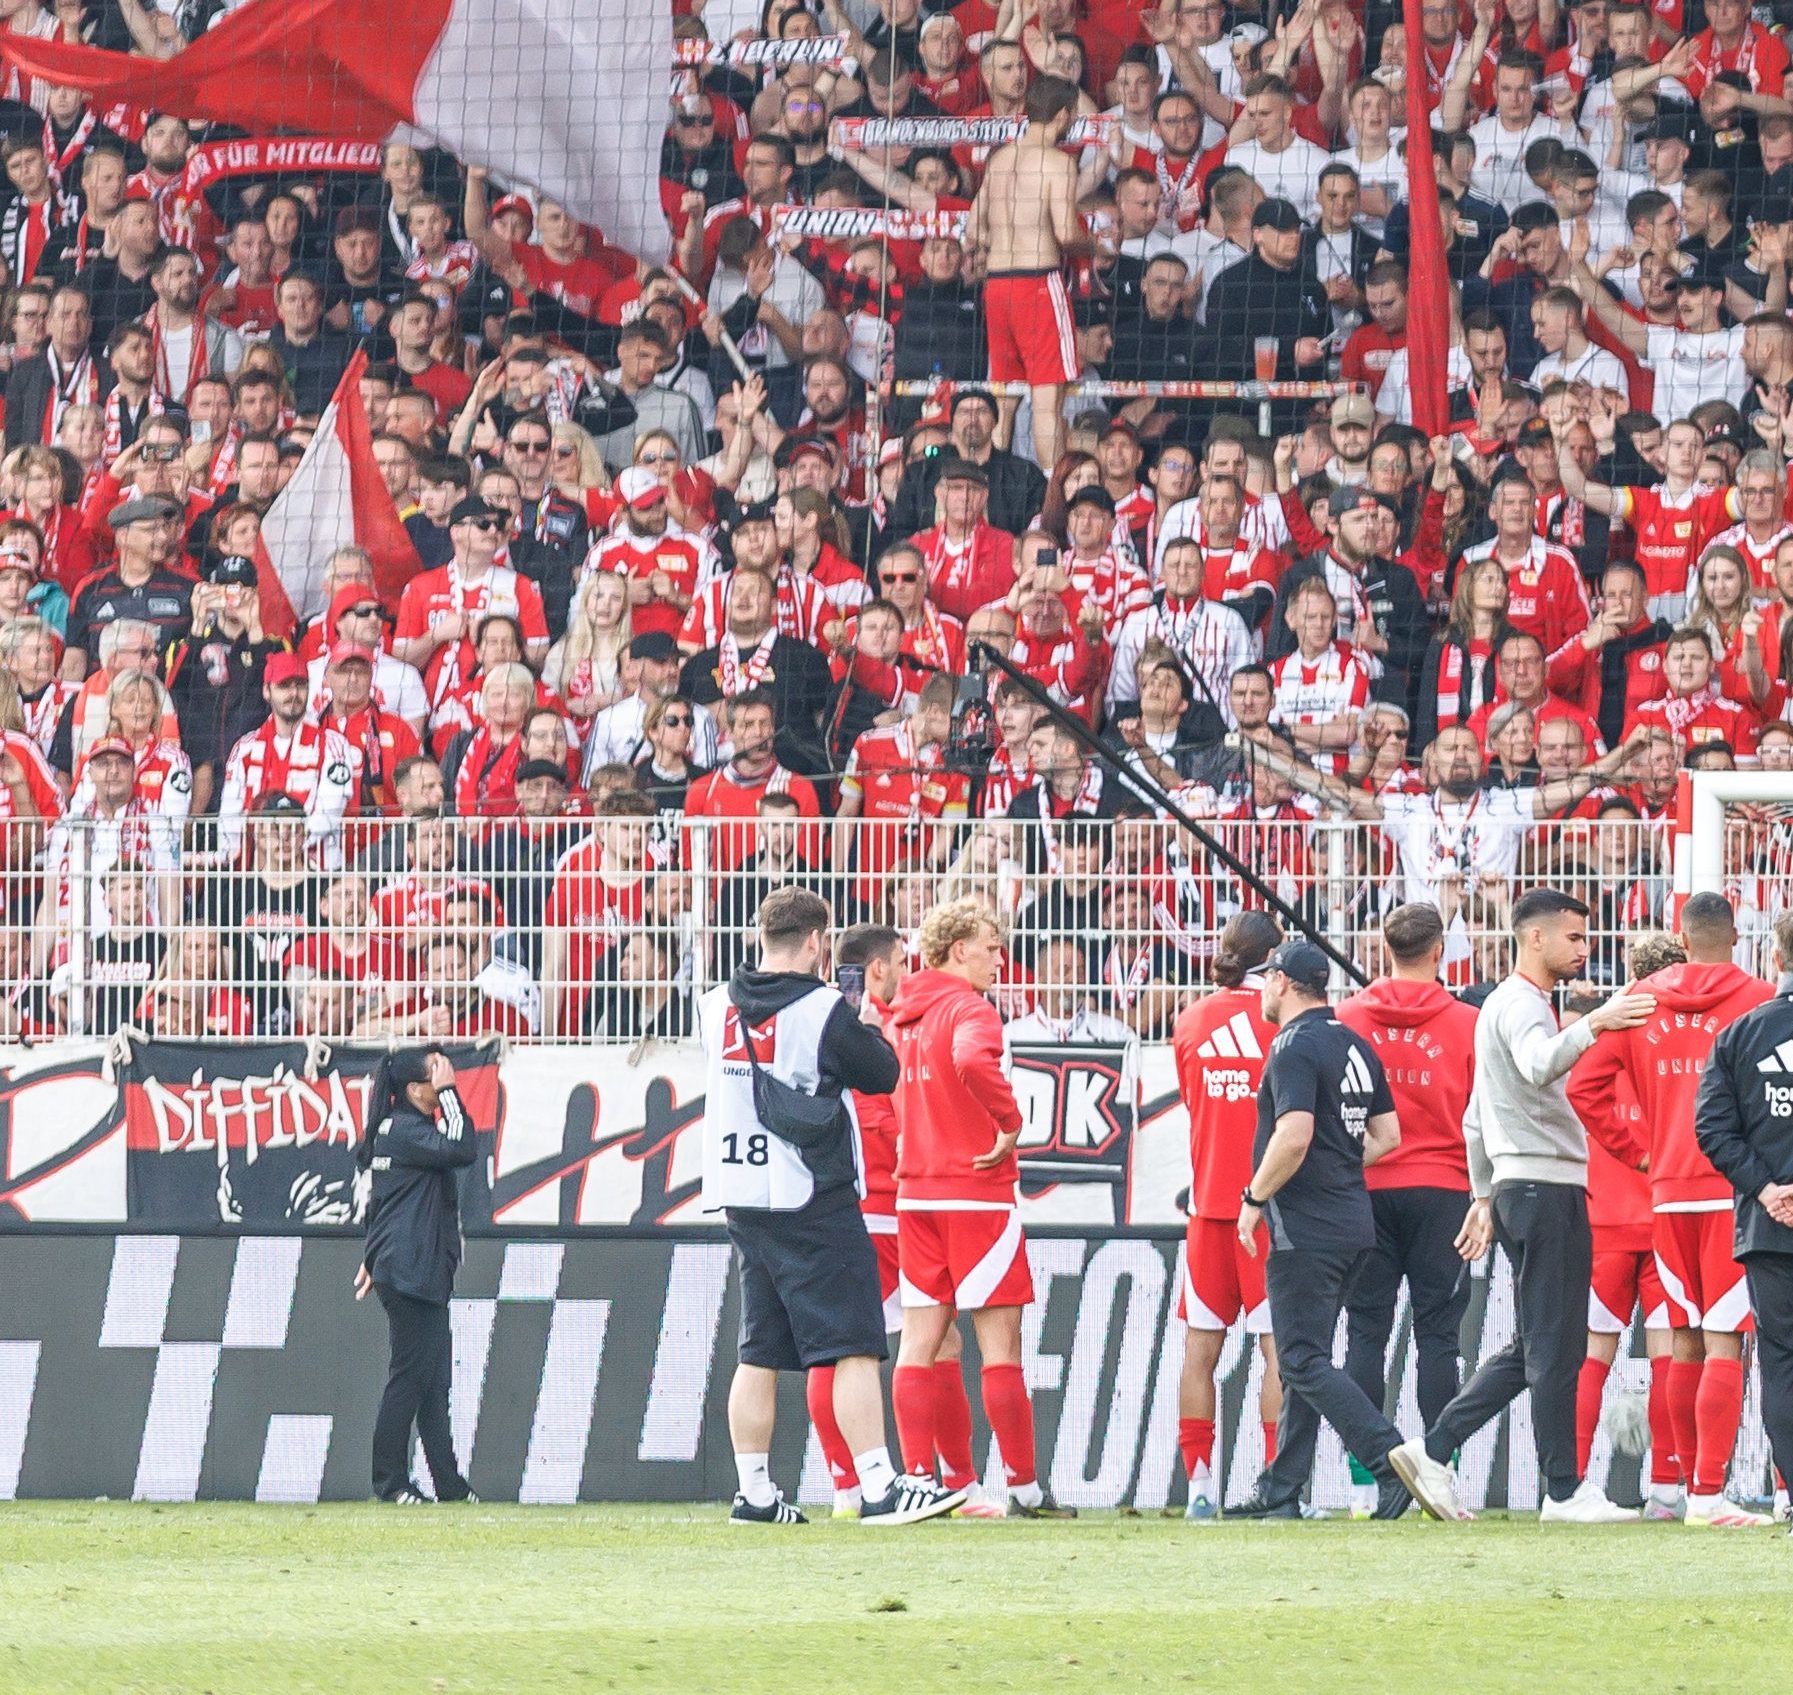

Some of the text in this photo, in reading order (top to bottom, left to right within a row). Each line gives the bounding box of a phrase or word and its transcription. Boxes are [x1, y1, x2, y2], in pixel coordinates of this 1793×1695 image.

[787, 211, 875, 239] UNION
[1645, 1011, 1717, 1047] EISER
[1372, 1027, 1446, 1061] ISERN
[1202, 1065, 1250, 1084] home
[1655, 1059, 1705, 1076] UNIO
[1208, 1080, 1224, 1099] to
[1770, 1100, 1792, 1118] to
[722, 1134, 769, 1168] 18
